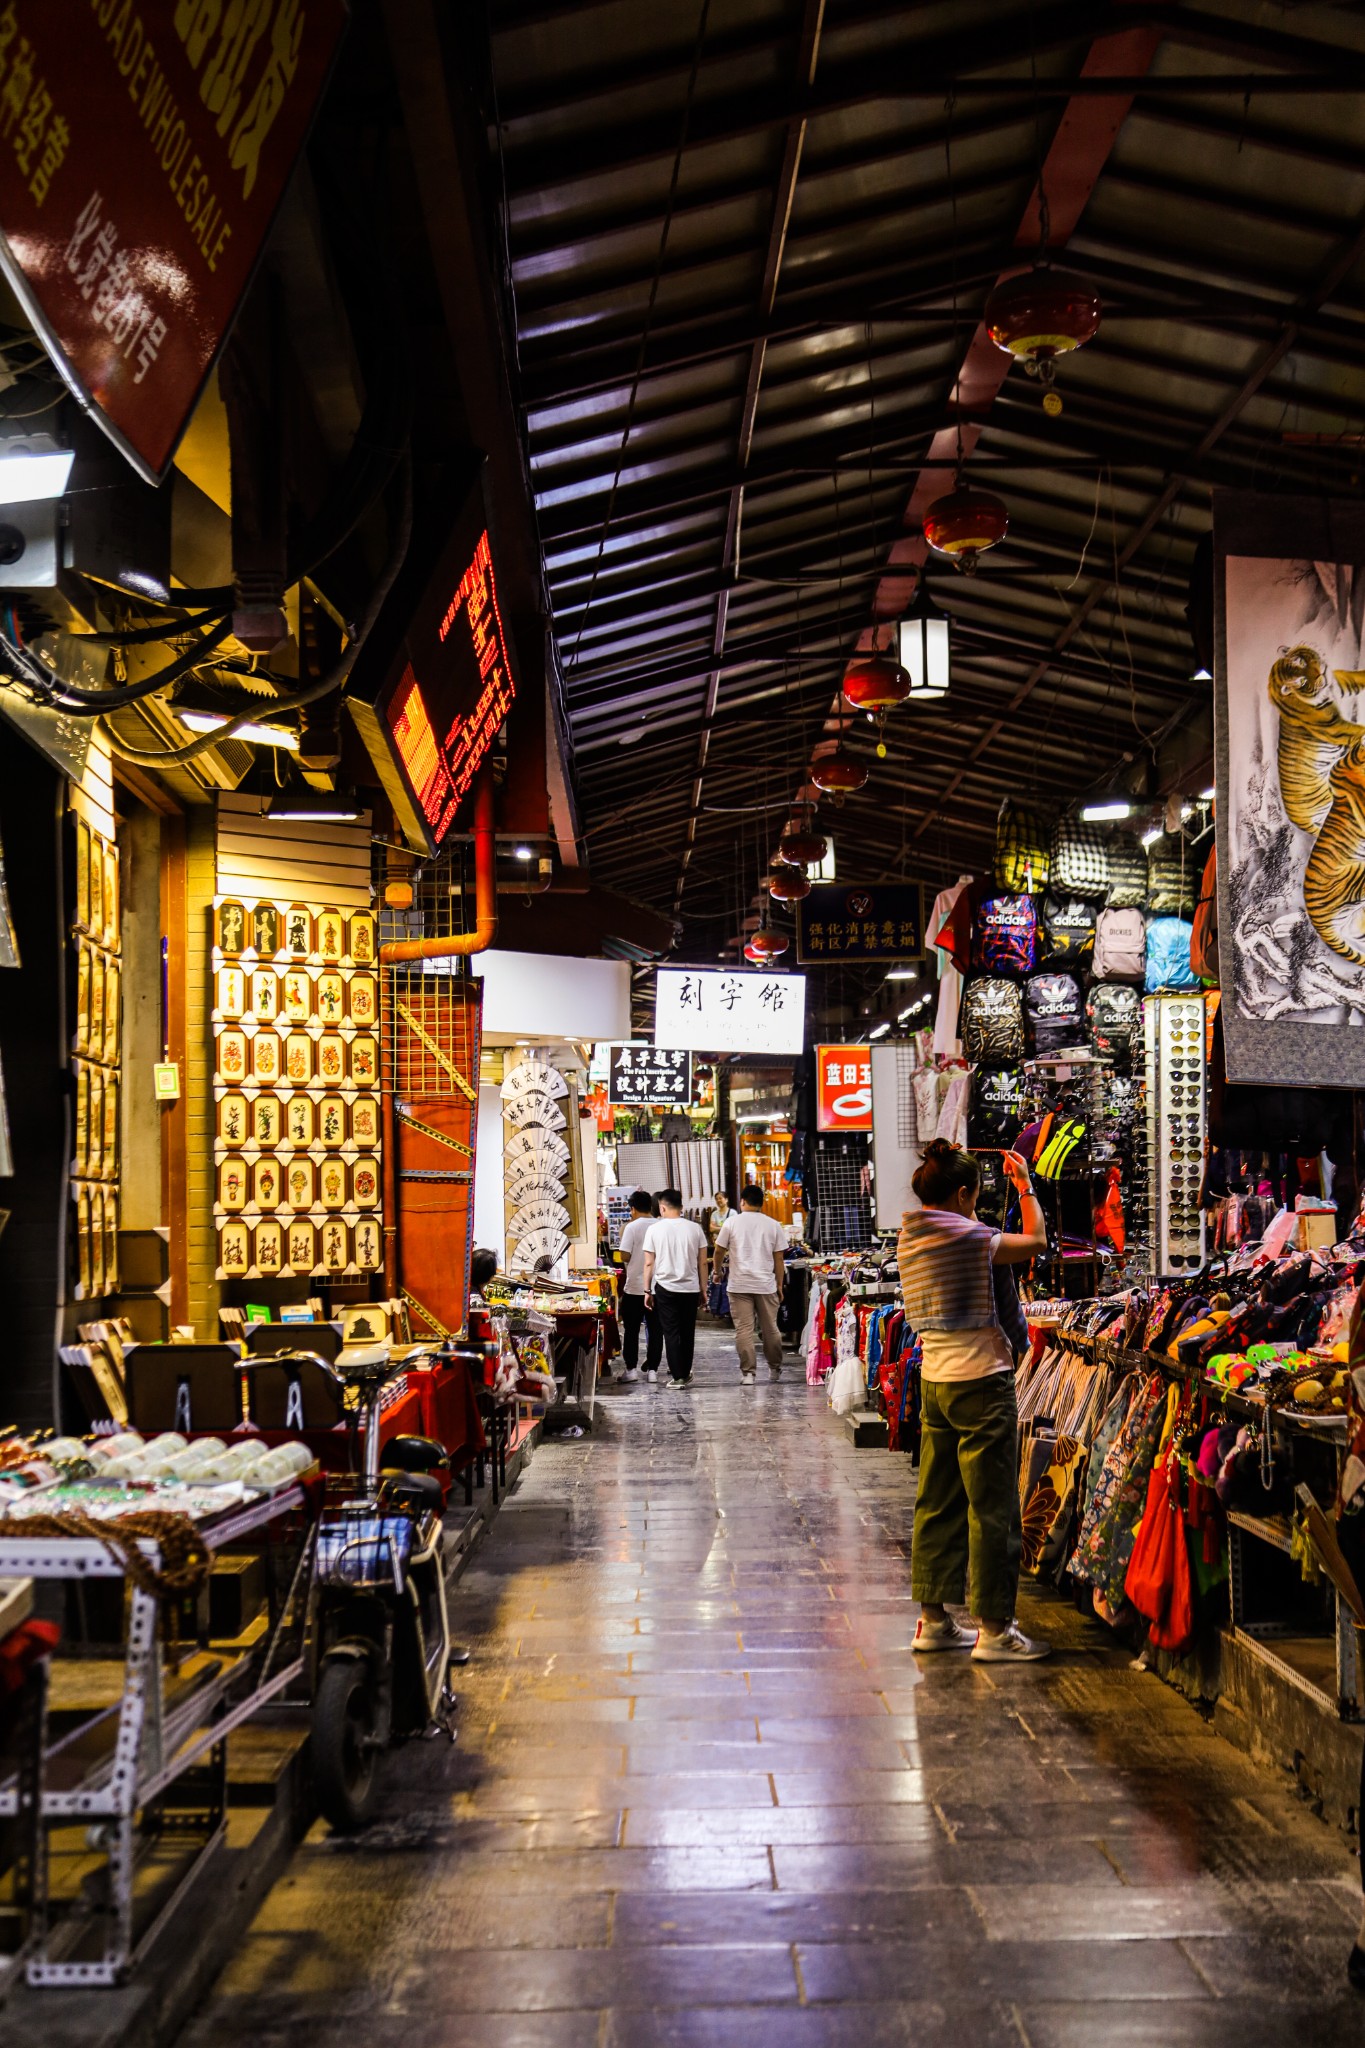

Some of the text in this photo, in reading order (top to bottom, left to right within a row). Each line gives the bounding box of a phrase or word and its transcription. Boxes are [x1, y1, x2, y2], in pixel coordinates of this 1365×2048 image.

[174, 0, 305, 200] 批发
[986, 914, 1027, 926] adidas
[1054, 915, 1092, 927] adidas
[809, 920, 914, 935] 强化消防意识
[1109, 928, 1132, 936] DICKIES
[809, 935, 915, 950] 街区严禁吸烟
[972, 1005, 1013, 1016] adidas
[1037, 1002, 1076, 1014] adidas
[1103, 1012, 1134, 1023] adid
[646, 1068, 677, 1077] Inscription
[623, 1094, 641, 1102] Design
[985, 1090, 1023, 1102] adidas
[1110, 1097, 1138, 1109] dida
